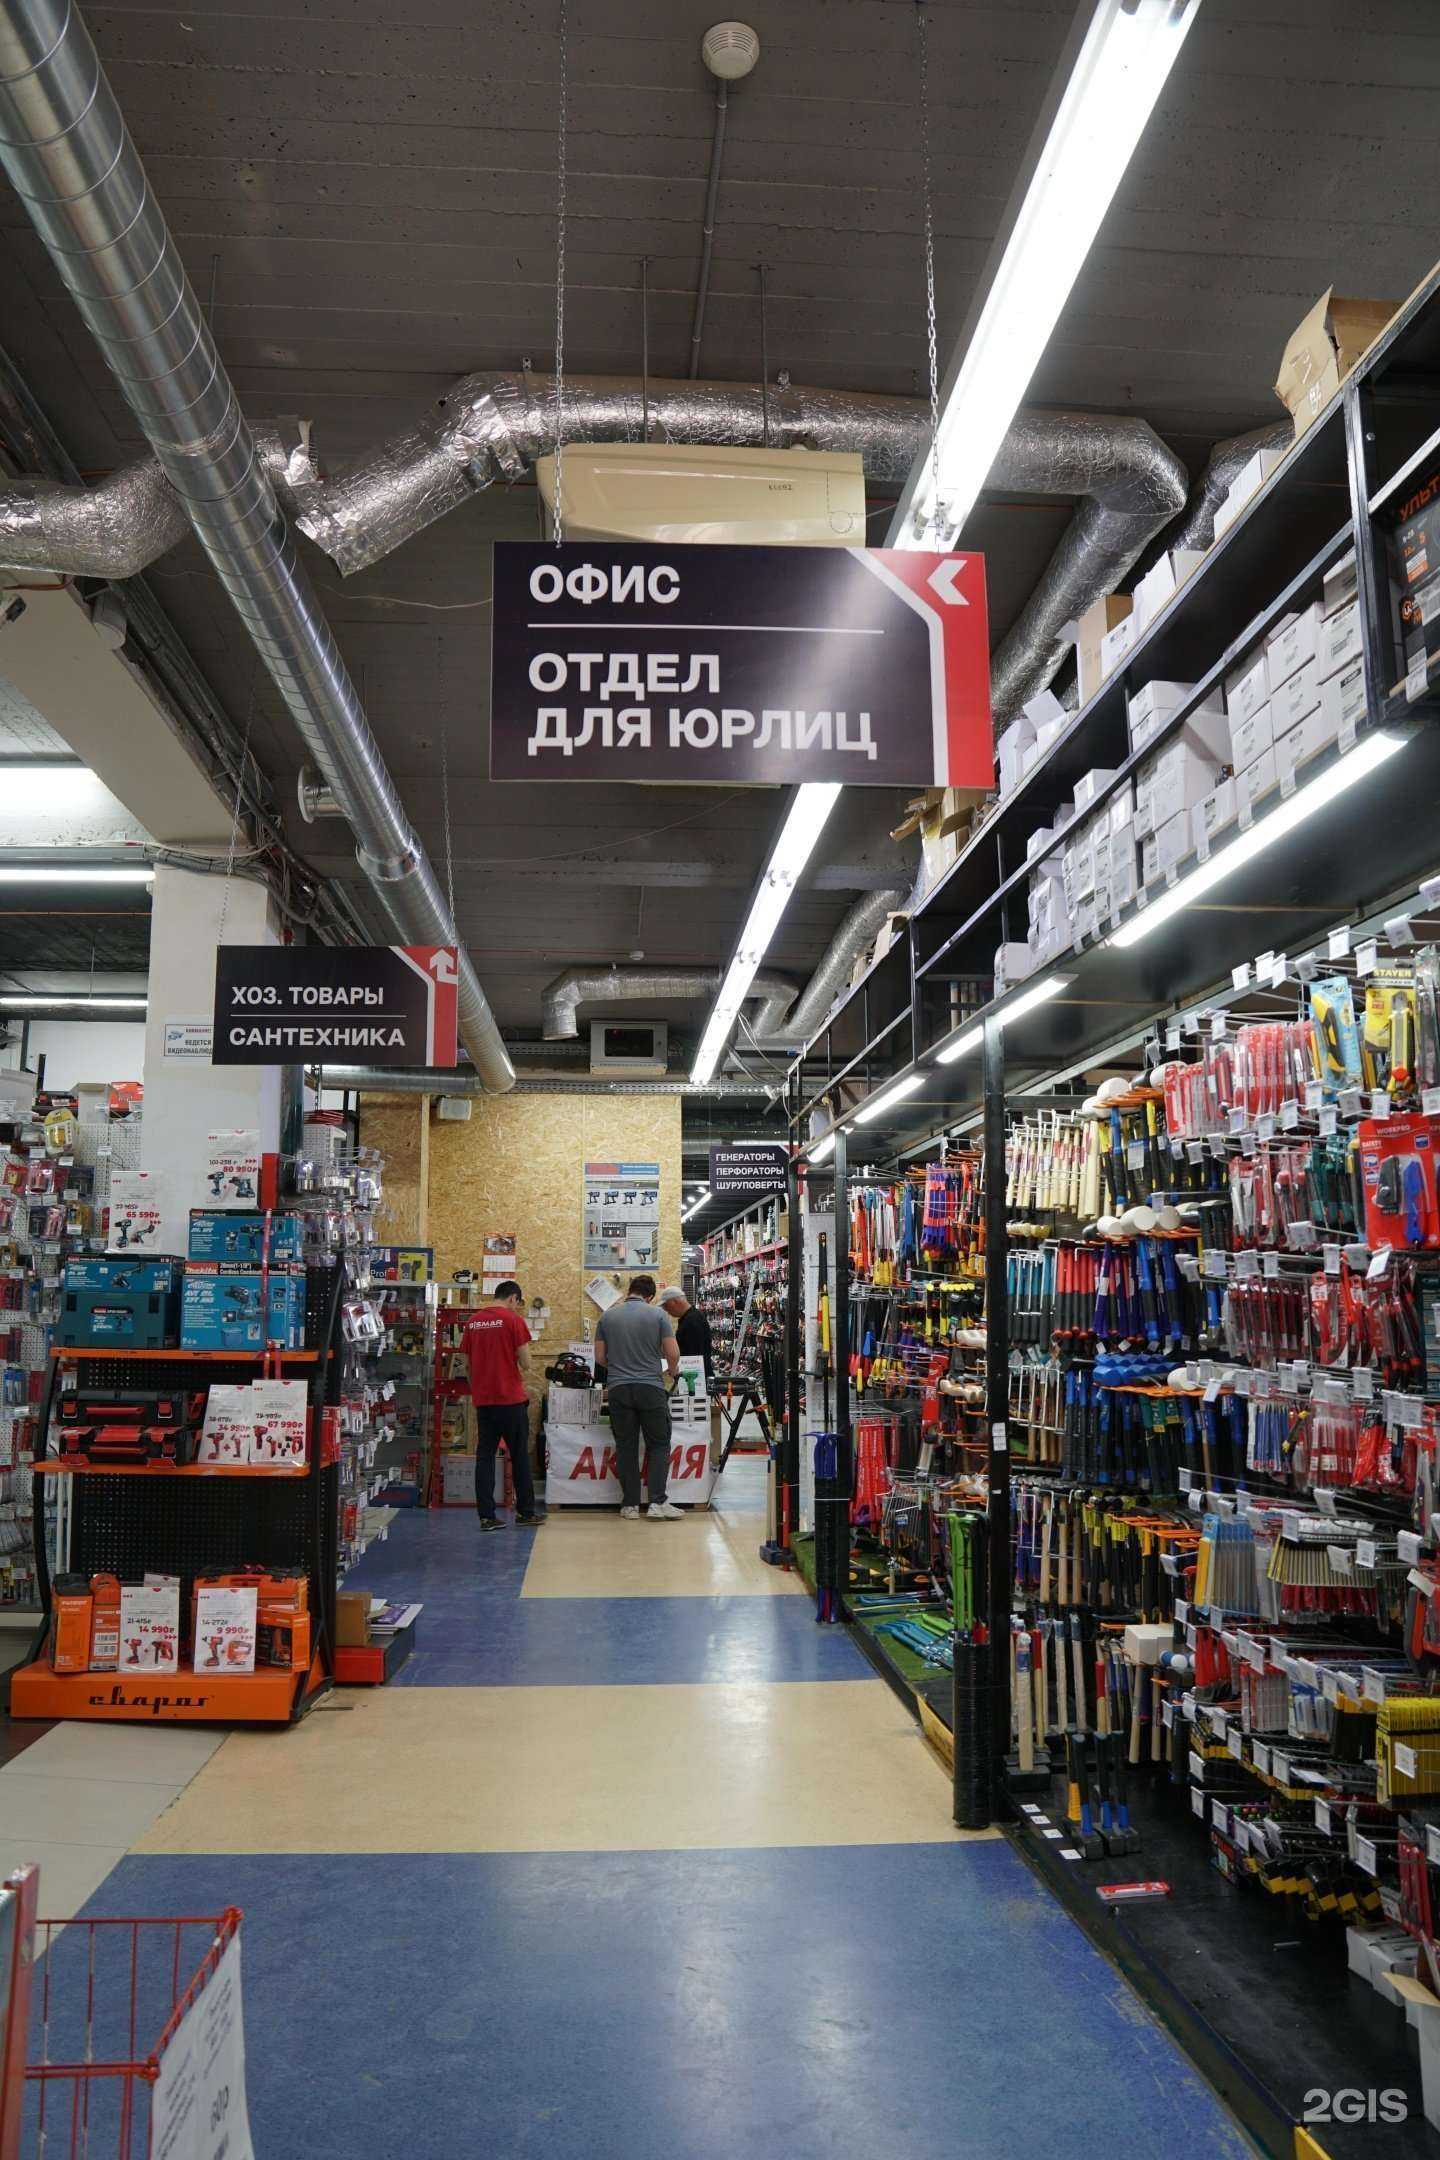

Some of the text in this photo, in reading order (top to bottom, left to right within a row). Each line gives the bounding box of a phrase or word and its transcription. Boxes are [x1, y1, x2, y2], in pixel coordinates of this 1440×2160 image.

[529, 563, 681, 605] ОФИС
[528, 652, 720, 701] ОТДЕЛ
[527, 707, 878, 760] ДЛЯ ЮРЛИЦ
[1373, 968, 1412, 978] STAYER
[231, 986, 384, 1005] ХОЗ. ТОВАРЫ
[229, 1027, 406, 1047] САНТЕХНИКА
[715, 1153, 775, 1162] ГЕНЕРАТОРЫ
[715, 1166, 785, 1176] ПЕРФОРАТОРЫ
[716, 1180, 786, 1190] ШУРУПОВЕРТЫ
[568, 1444, 707, 1487] АКИЯ
